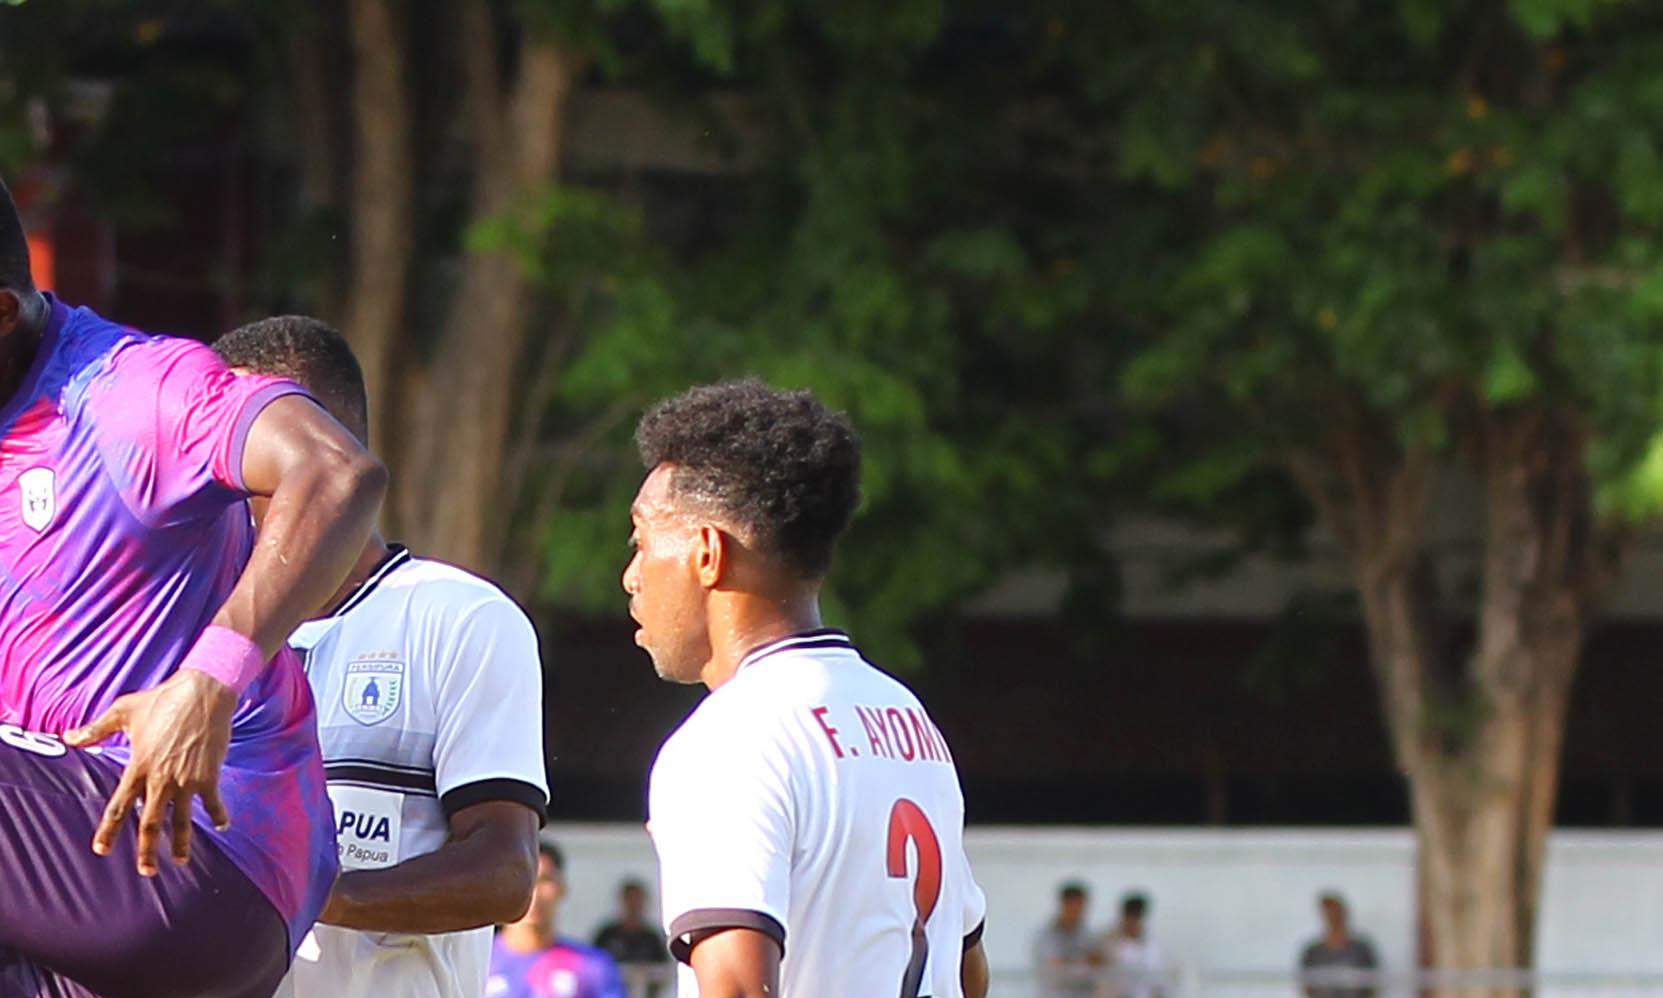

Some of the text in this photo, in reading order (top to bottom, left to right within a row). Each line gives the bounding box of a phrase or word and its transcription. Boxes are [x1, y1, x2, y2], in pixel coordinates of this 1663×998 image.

[810, 705, 859, 760] F.
[338, 810, 390, 841] PUA
[346, 843, 389, 863] Papua
